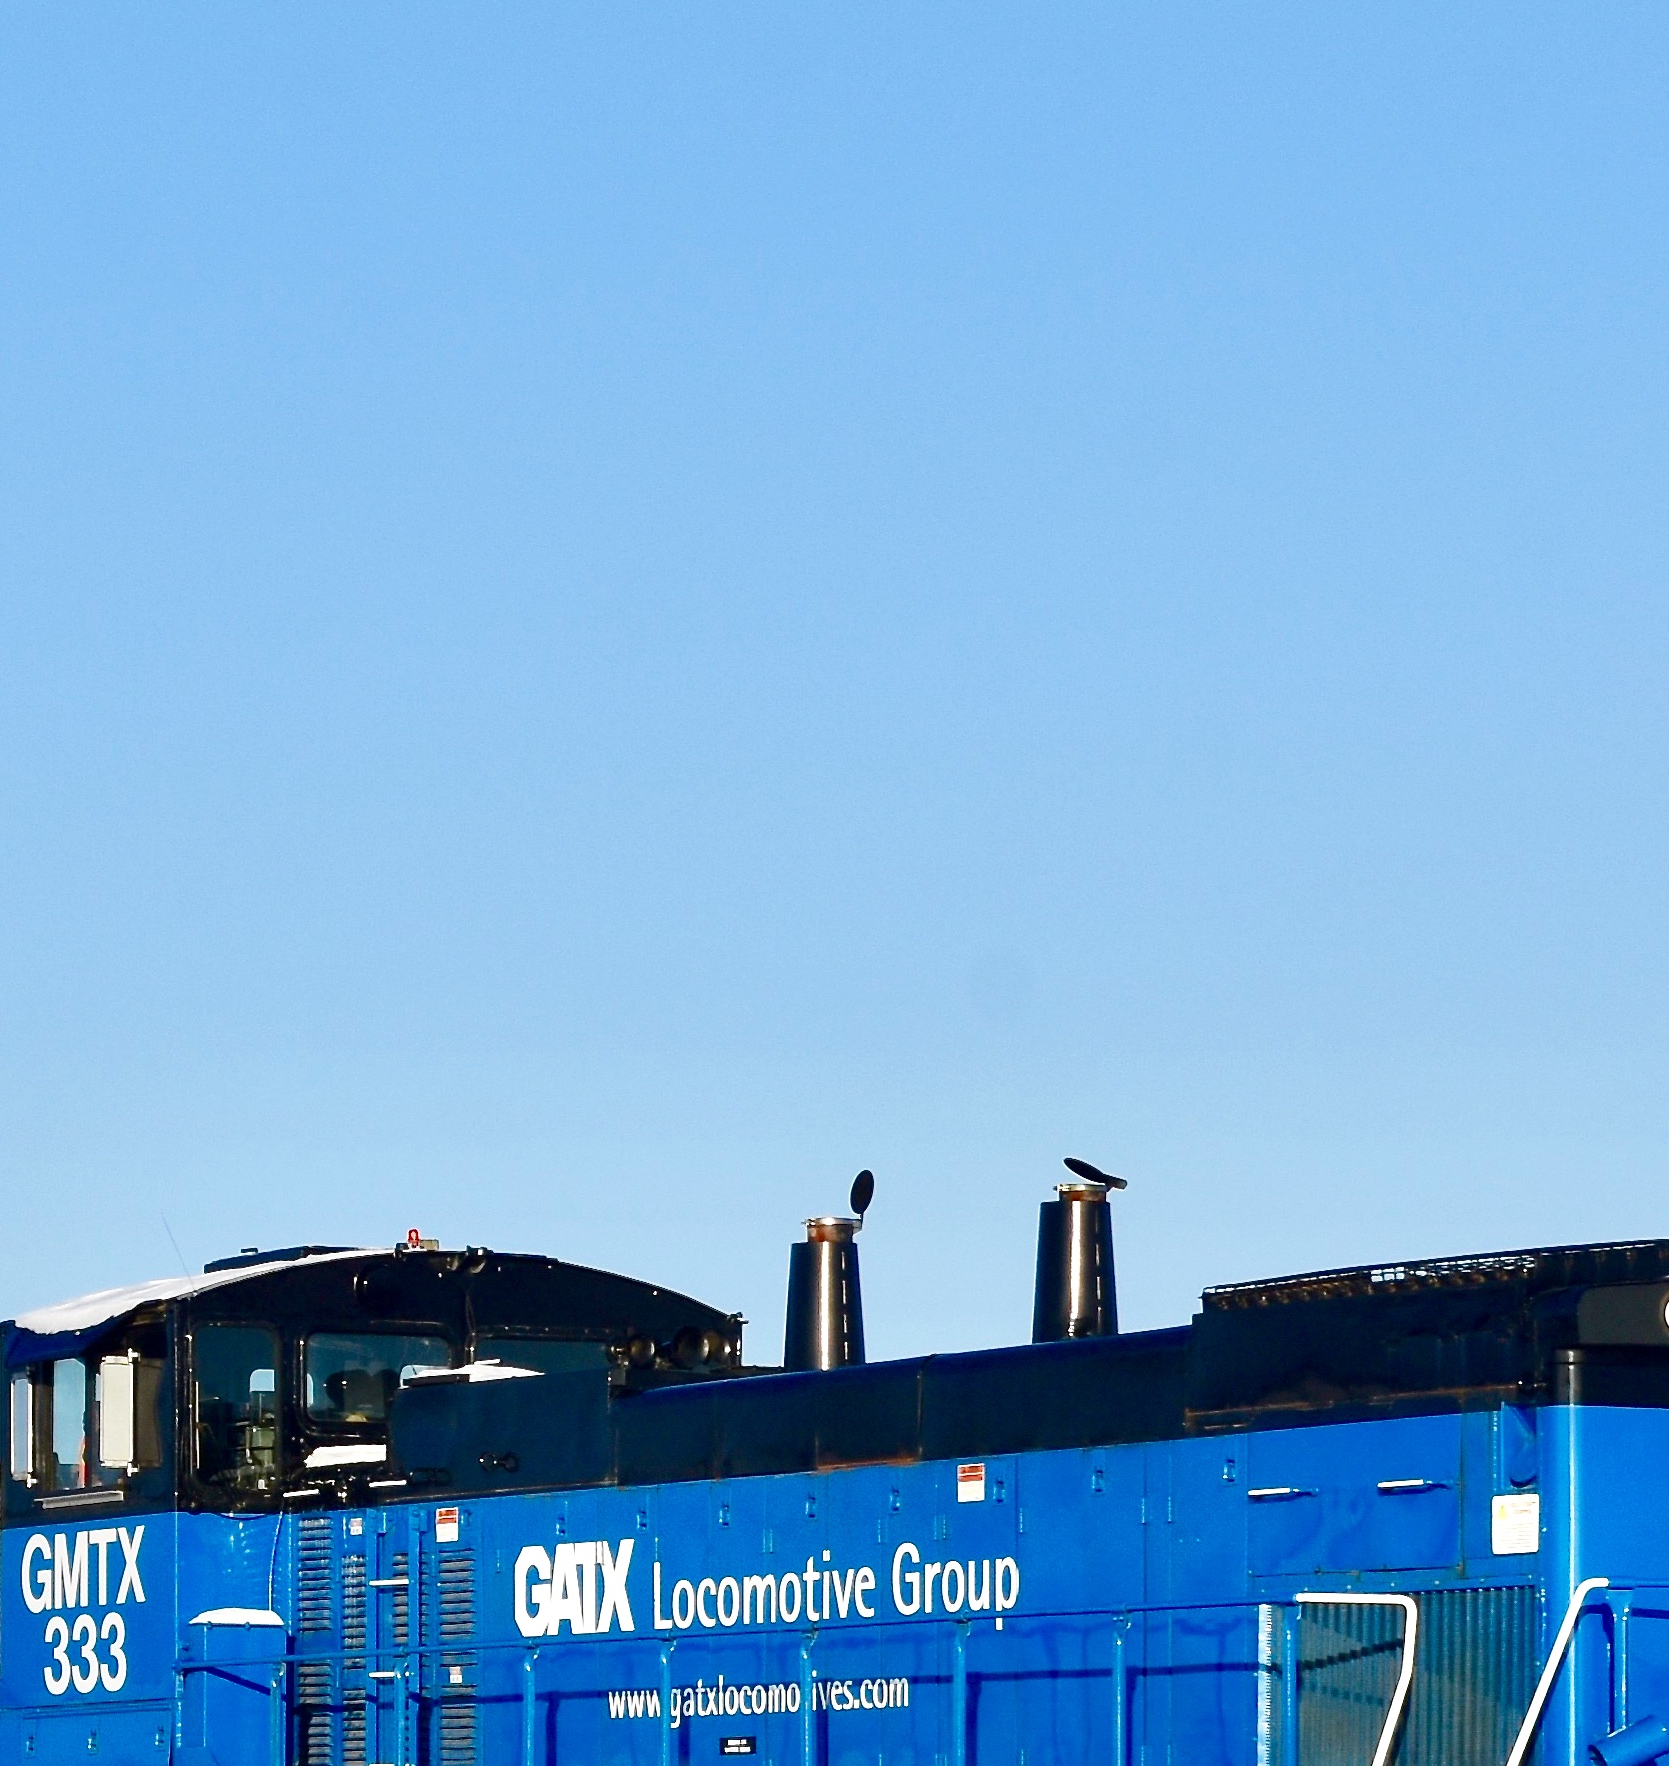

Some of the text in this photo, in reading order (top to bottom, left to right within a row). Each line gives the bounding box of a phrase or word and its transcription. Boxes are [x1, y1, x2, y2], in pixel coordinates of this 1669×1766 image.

[21, 1525, 146, 1614] GMTX
[514, 1538, 1020, 1638] GATX Locomotive Group
[43, 1613, 127, 1696] 333
[608, 1669, 909, 1728] wwwgatxlocomoives.com
